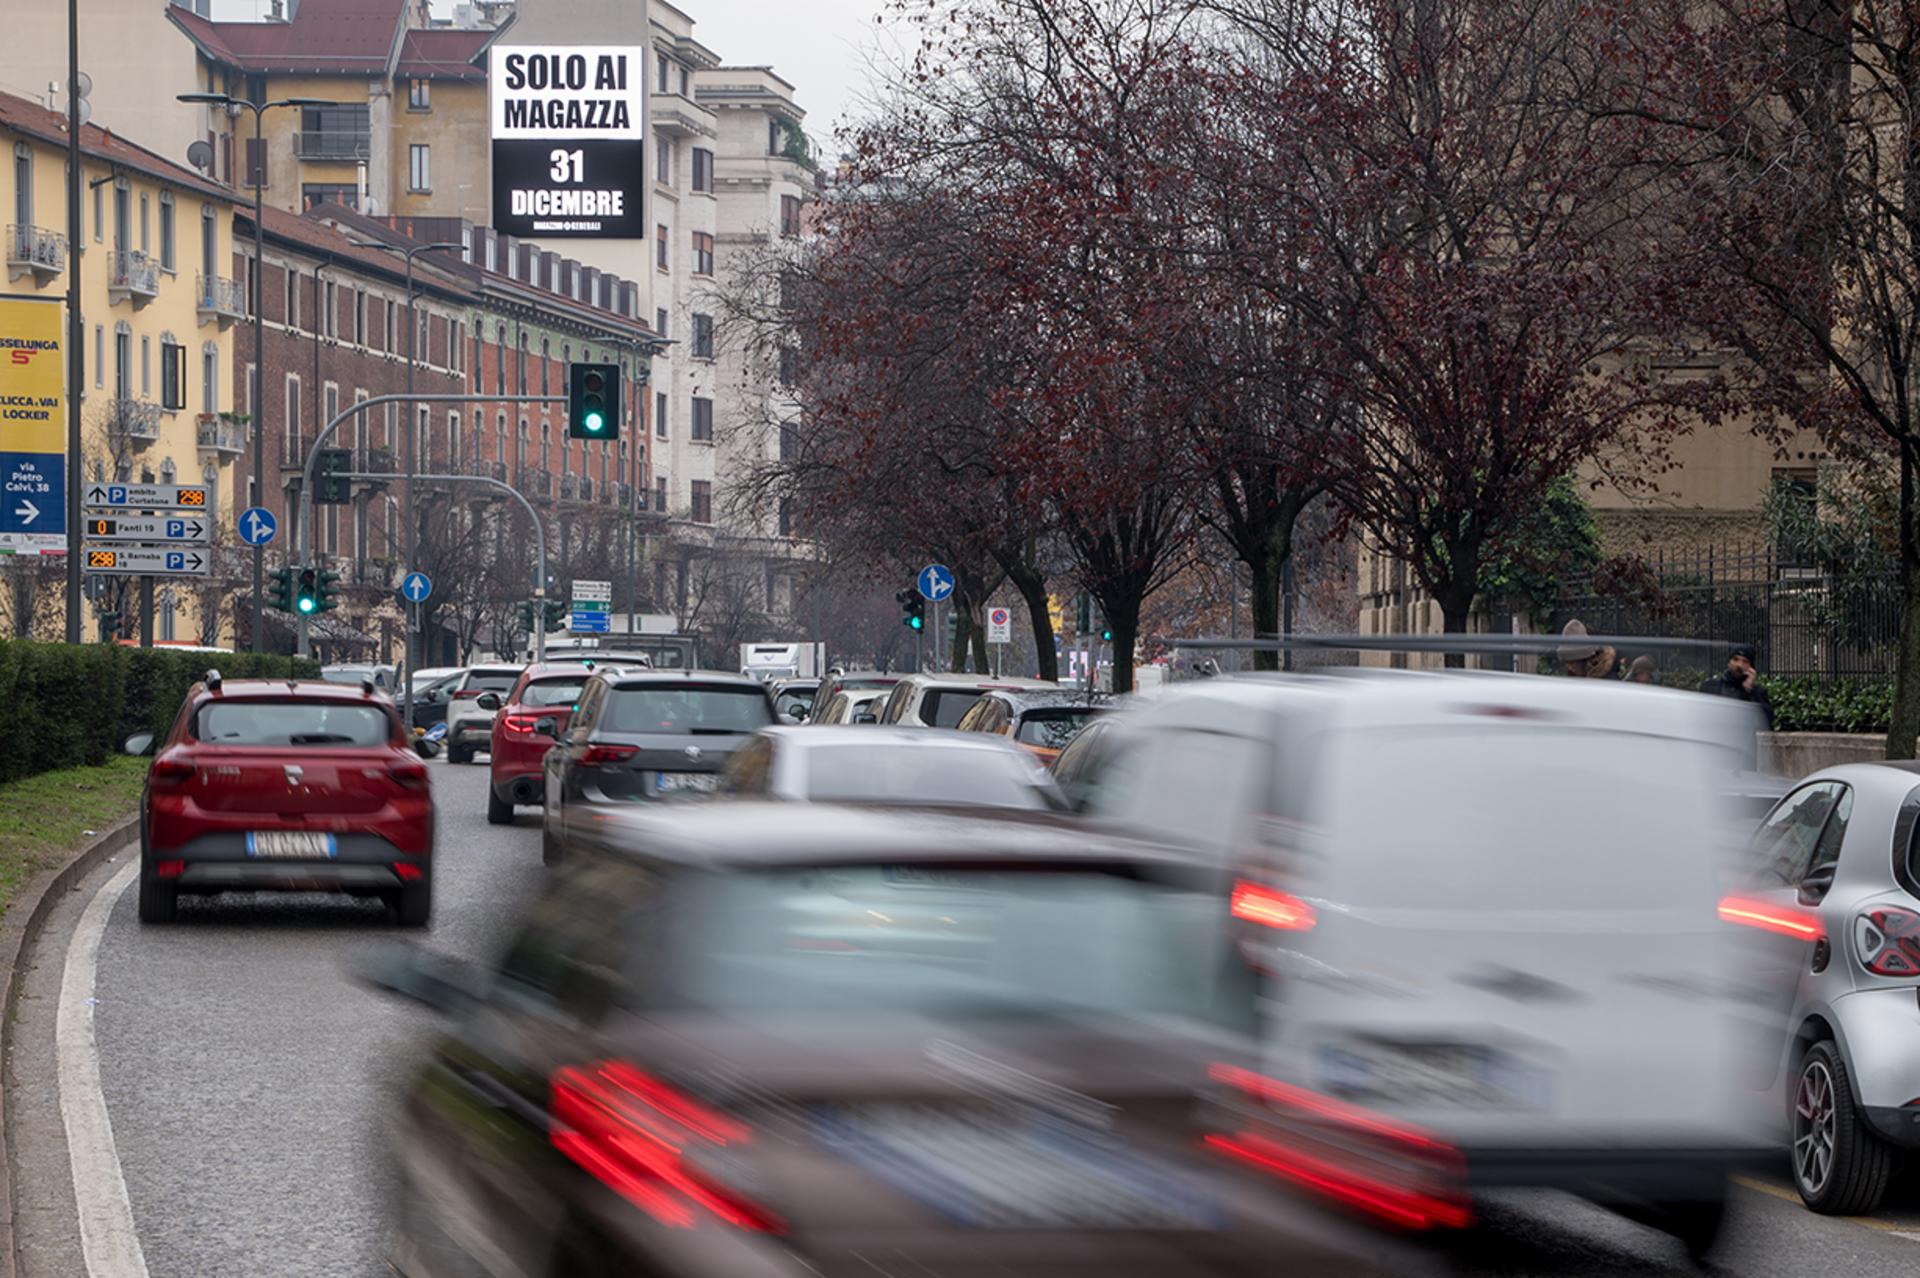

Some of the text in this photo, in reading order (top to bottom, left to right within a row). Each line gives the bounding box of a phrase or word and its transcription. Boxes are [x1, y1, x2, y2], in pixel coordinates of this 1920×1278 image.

[505, 54, 627, 91] SOLO AI
[504, 99, 630, 129] MAGAZZA
[550, 149, 583, 183] 31
[511, 190, 624, 216] DICEMBRE
[3, 409, 49, 420] LOCKER
[20, 462, 35, 471] via
[12, 472, 44, 482] Pietro
[5, 482, 50, 493] Calvi, 38
[128, 488, 157, 496] ambito
[180, 489, 204, 506] 298
[118, 523, 142, 532] Fanti
[144, 523, 155, 533] 19
[90, 551, 114, 567] 298
